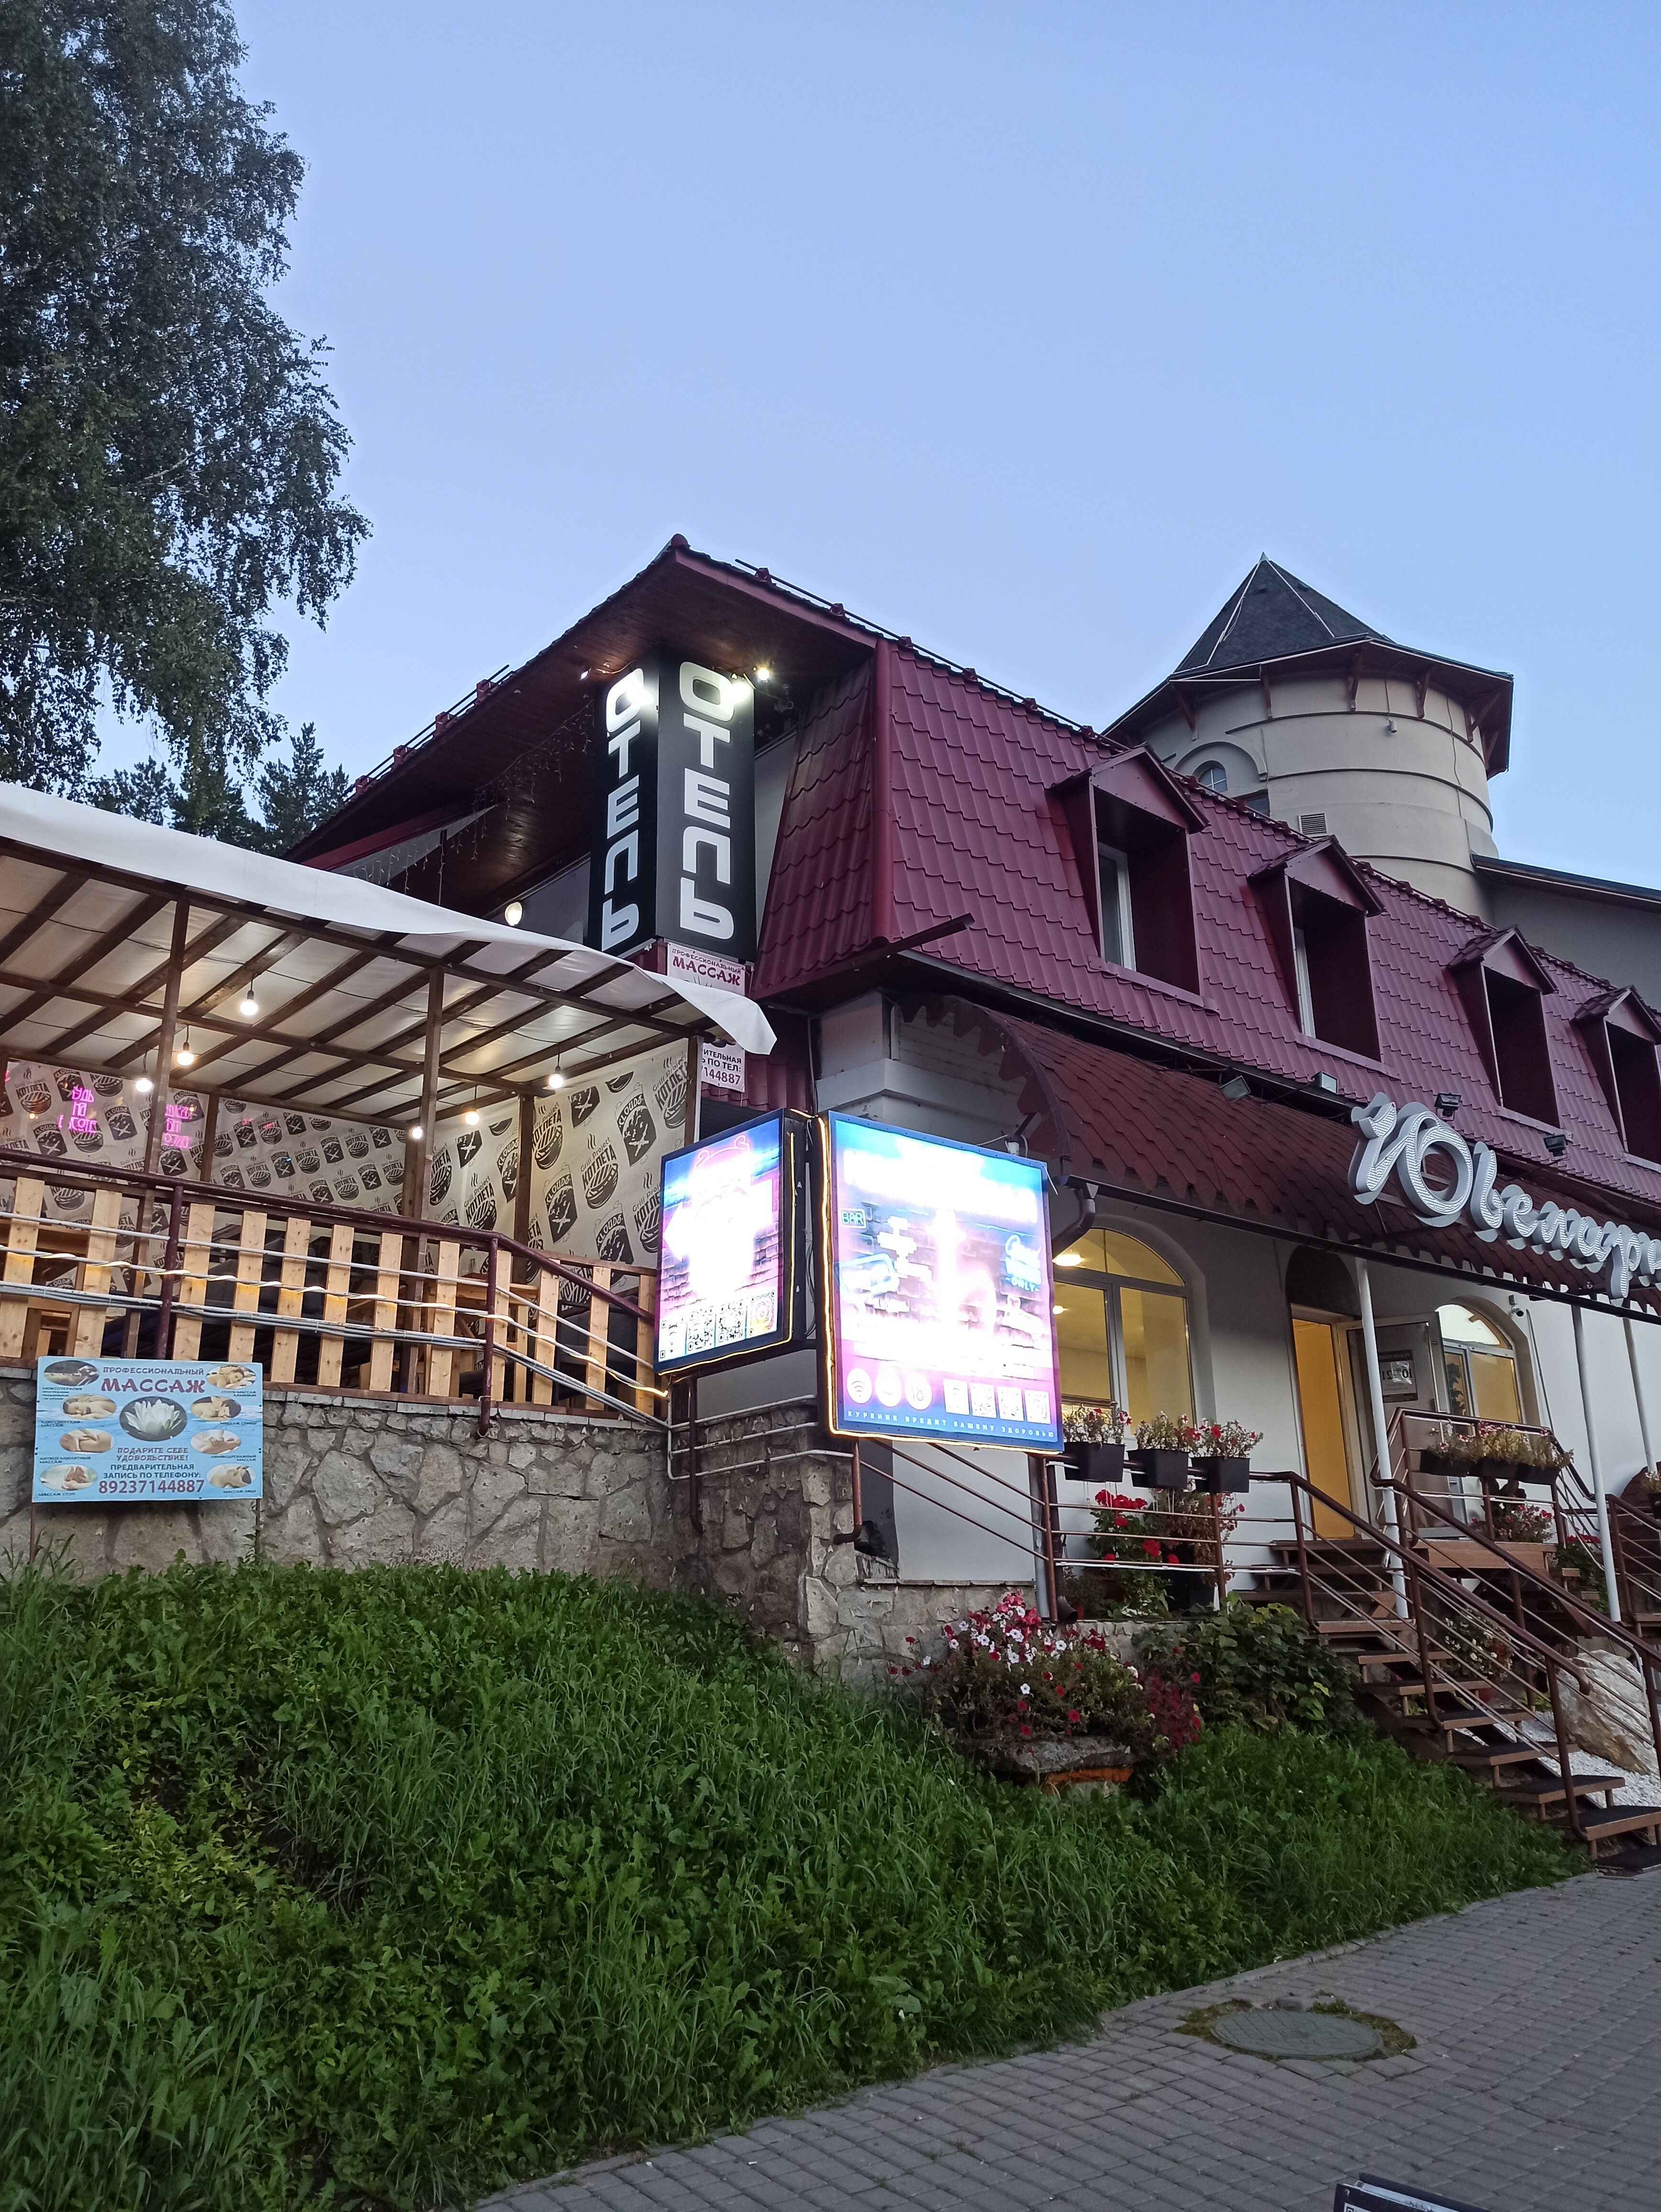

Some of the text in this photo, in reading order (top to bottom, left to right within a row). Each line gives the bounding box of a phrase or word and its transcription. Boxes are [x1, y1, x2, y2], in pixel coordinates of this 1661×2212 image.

[601, 668, 644, 952] ОТЕЛЬ
[679, 661, 735, 940] ОТЕЛЬ
[672, 948, 742, 974] ПРОФЕССИОНАЛЬНЫЙ
[673, 956, 741, 986] МАССАЖ
[704, 1049, 742, 1064] ИТЕЛЬНАЯ
[708, 1058, 720, 1068] ПО
[654, 1061, 687, 1111] КОТЛЕТ
[703, 1067, 742, 1085] 144887
[16, 1083, 50, 1099] КОТЛЕТА
[106, 1106, 128, 1118] CLOUDS
[542, 1102, 560, 1122] Project
[619, 1095, 644, 1127] CLOUDS
[345, 1135, 367, 1148] КОТЛЕТА
[295, 1149, 318, 1163] КОТЛЕТА
[431, 1150, 451, 1174] ТЛЕТА
[580, 1137, 611, 1172] Grill Project
[246, 1164, 269, 1177] КОТЛЕТА
[383, 1161, 403, 1175] КОТЛЕТА
[582, 1144, 617, 1190] КОТЛЕТА
[334, 1177, 357, 1190] КОТЛЕТА
[464, 1175, 490, 1208] Grill Project
[547, 1174, 571, 1205] CLOUDS
[465, 1183, 495, 1225] КОТЛЕТА
[632, 1183, 660, 1212] Grill Proj
[634, 1191, 661, 1232] КОТЛЕ
[842, 1212, 864, 1225] BAR
[598, 1214, 623, 1245] CLOUDS
[103, 1367, 204, 1375] ПРОФЕССИОНАЛЬНЫЙ
[101, 1378, 206, 1393] МАССАЖ
[848, 1411, 1054, 1438] КУРЕНИЕ ВРЕДИТ ВАШЕМУ ЗДОРОВЬЮ
[99, 1479, 205, 1493] 89237144887
